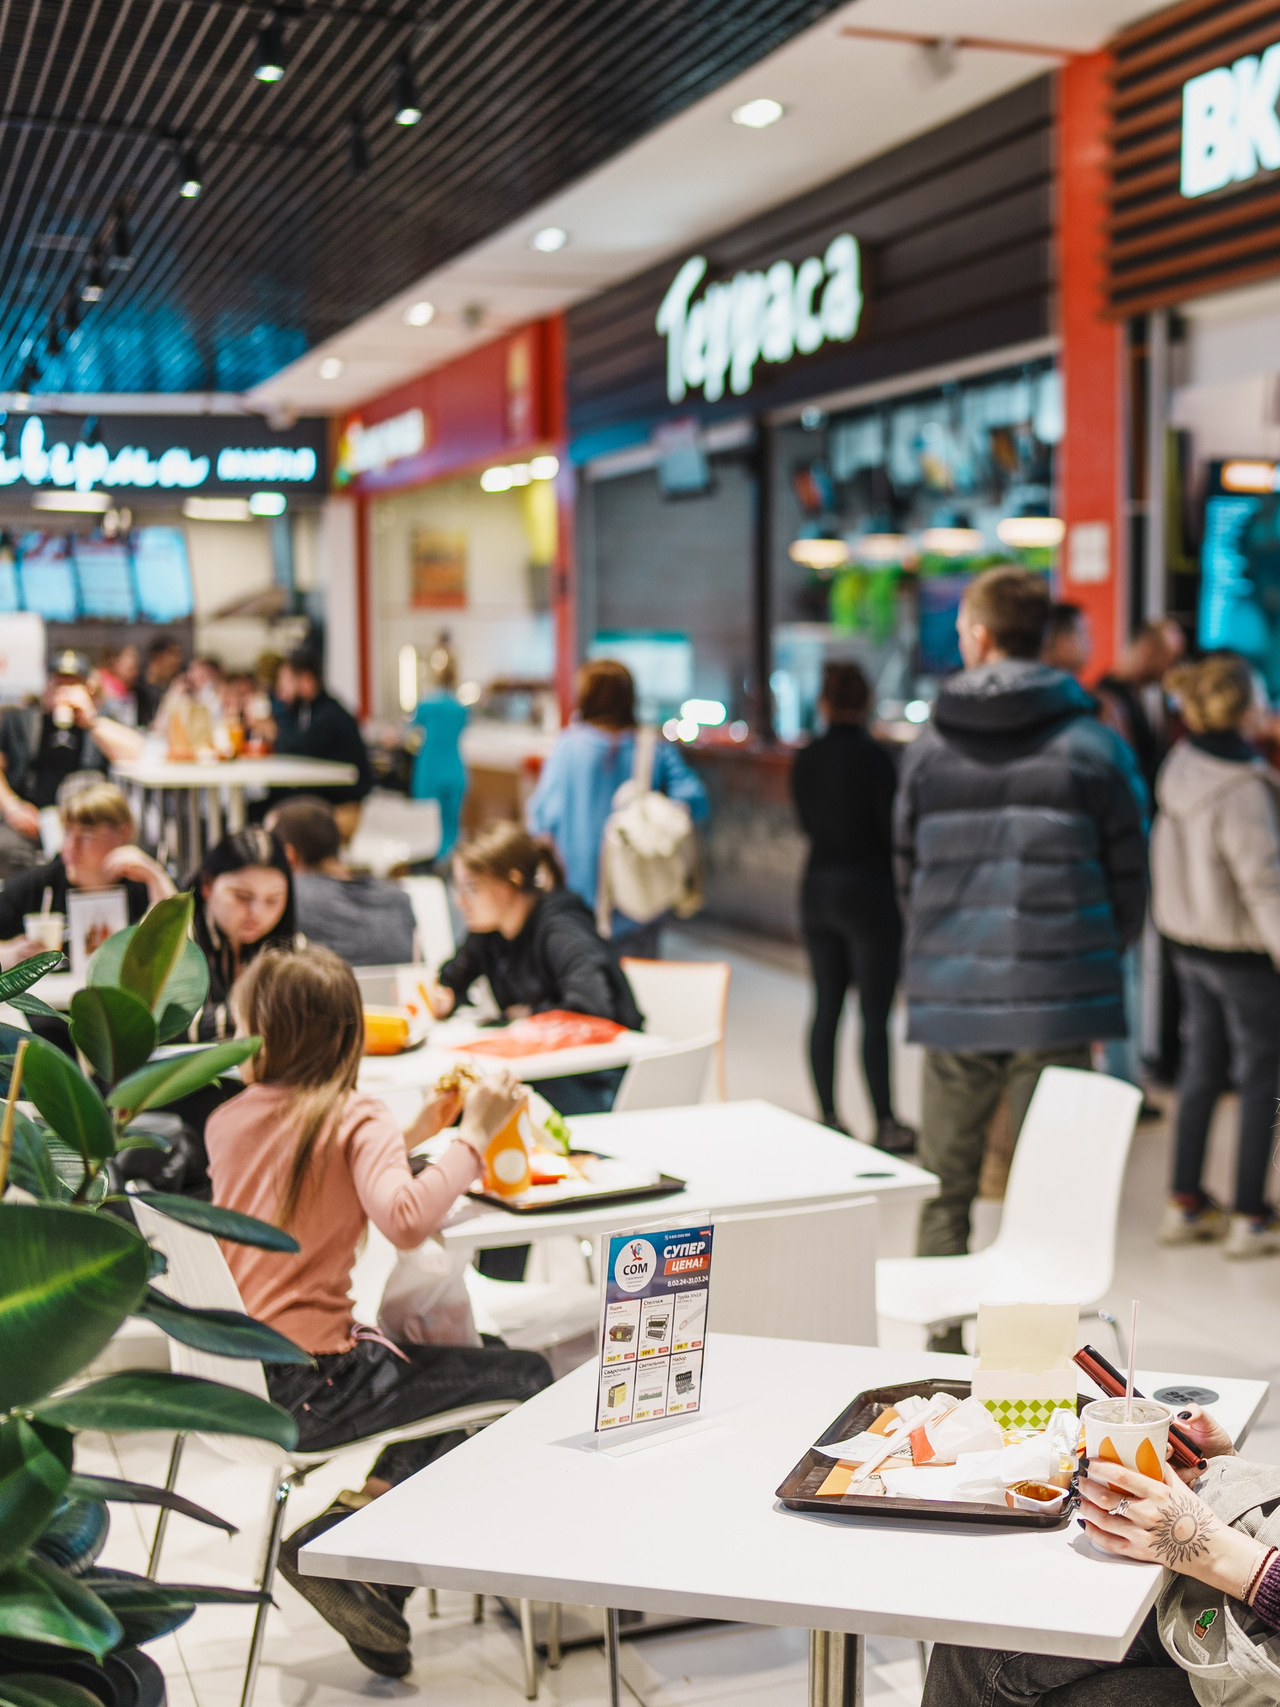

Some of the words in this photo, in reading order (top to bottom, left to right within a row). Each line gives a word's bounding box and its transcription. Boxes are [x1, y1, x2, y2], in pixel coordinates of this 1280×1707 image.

[655, 232, 863, 405] Терраса
[663, 1241, 706, 1259] СУПЕР
[622, 1262, 648, 1276] СОМ
[671, 1257, 704, 1272] ЦЕНА!
[667, 1275, 709, 1288] 8.02.24-31.03.24
